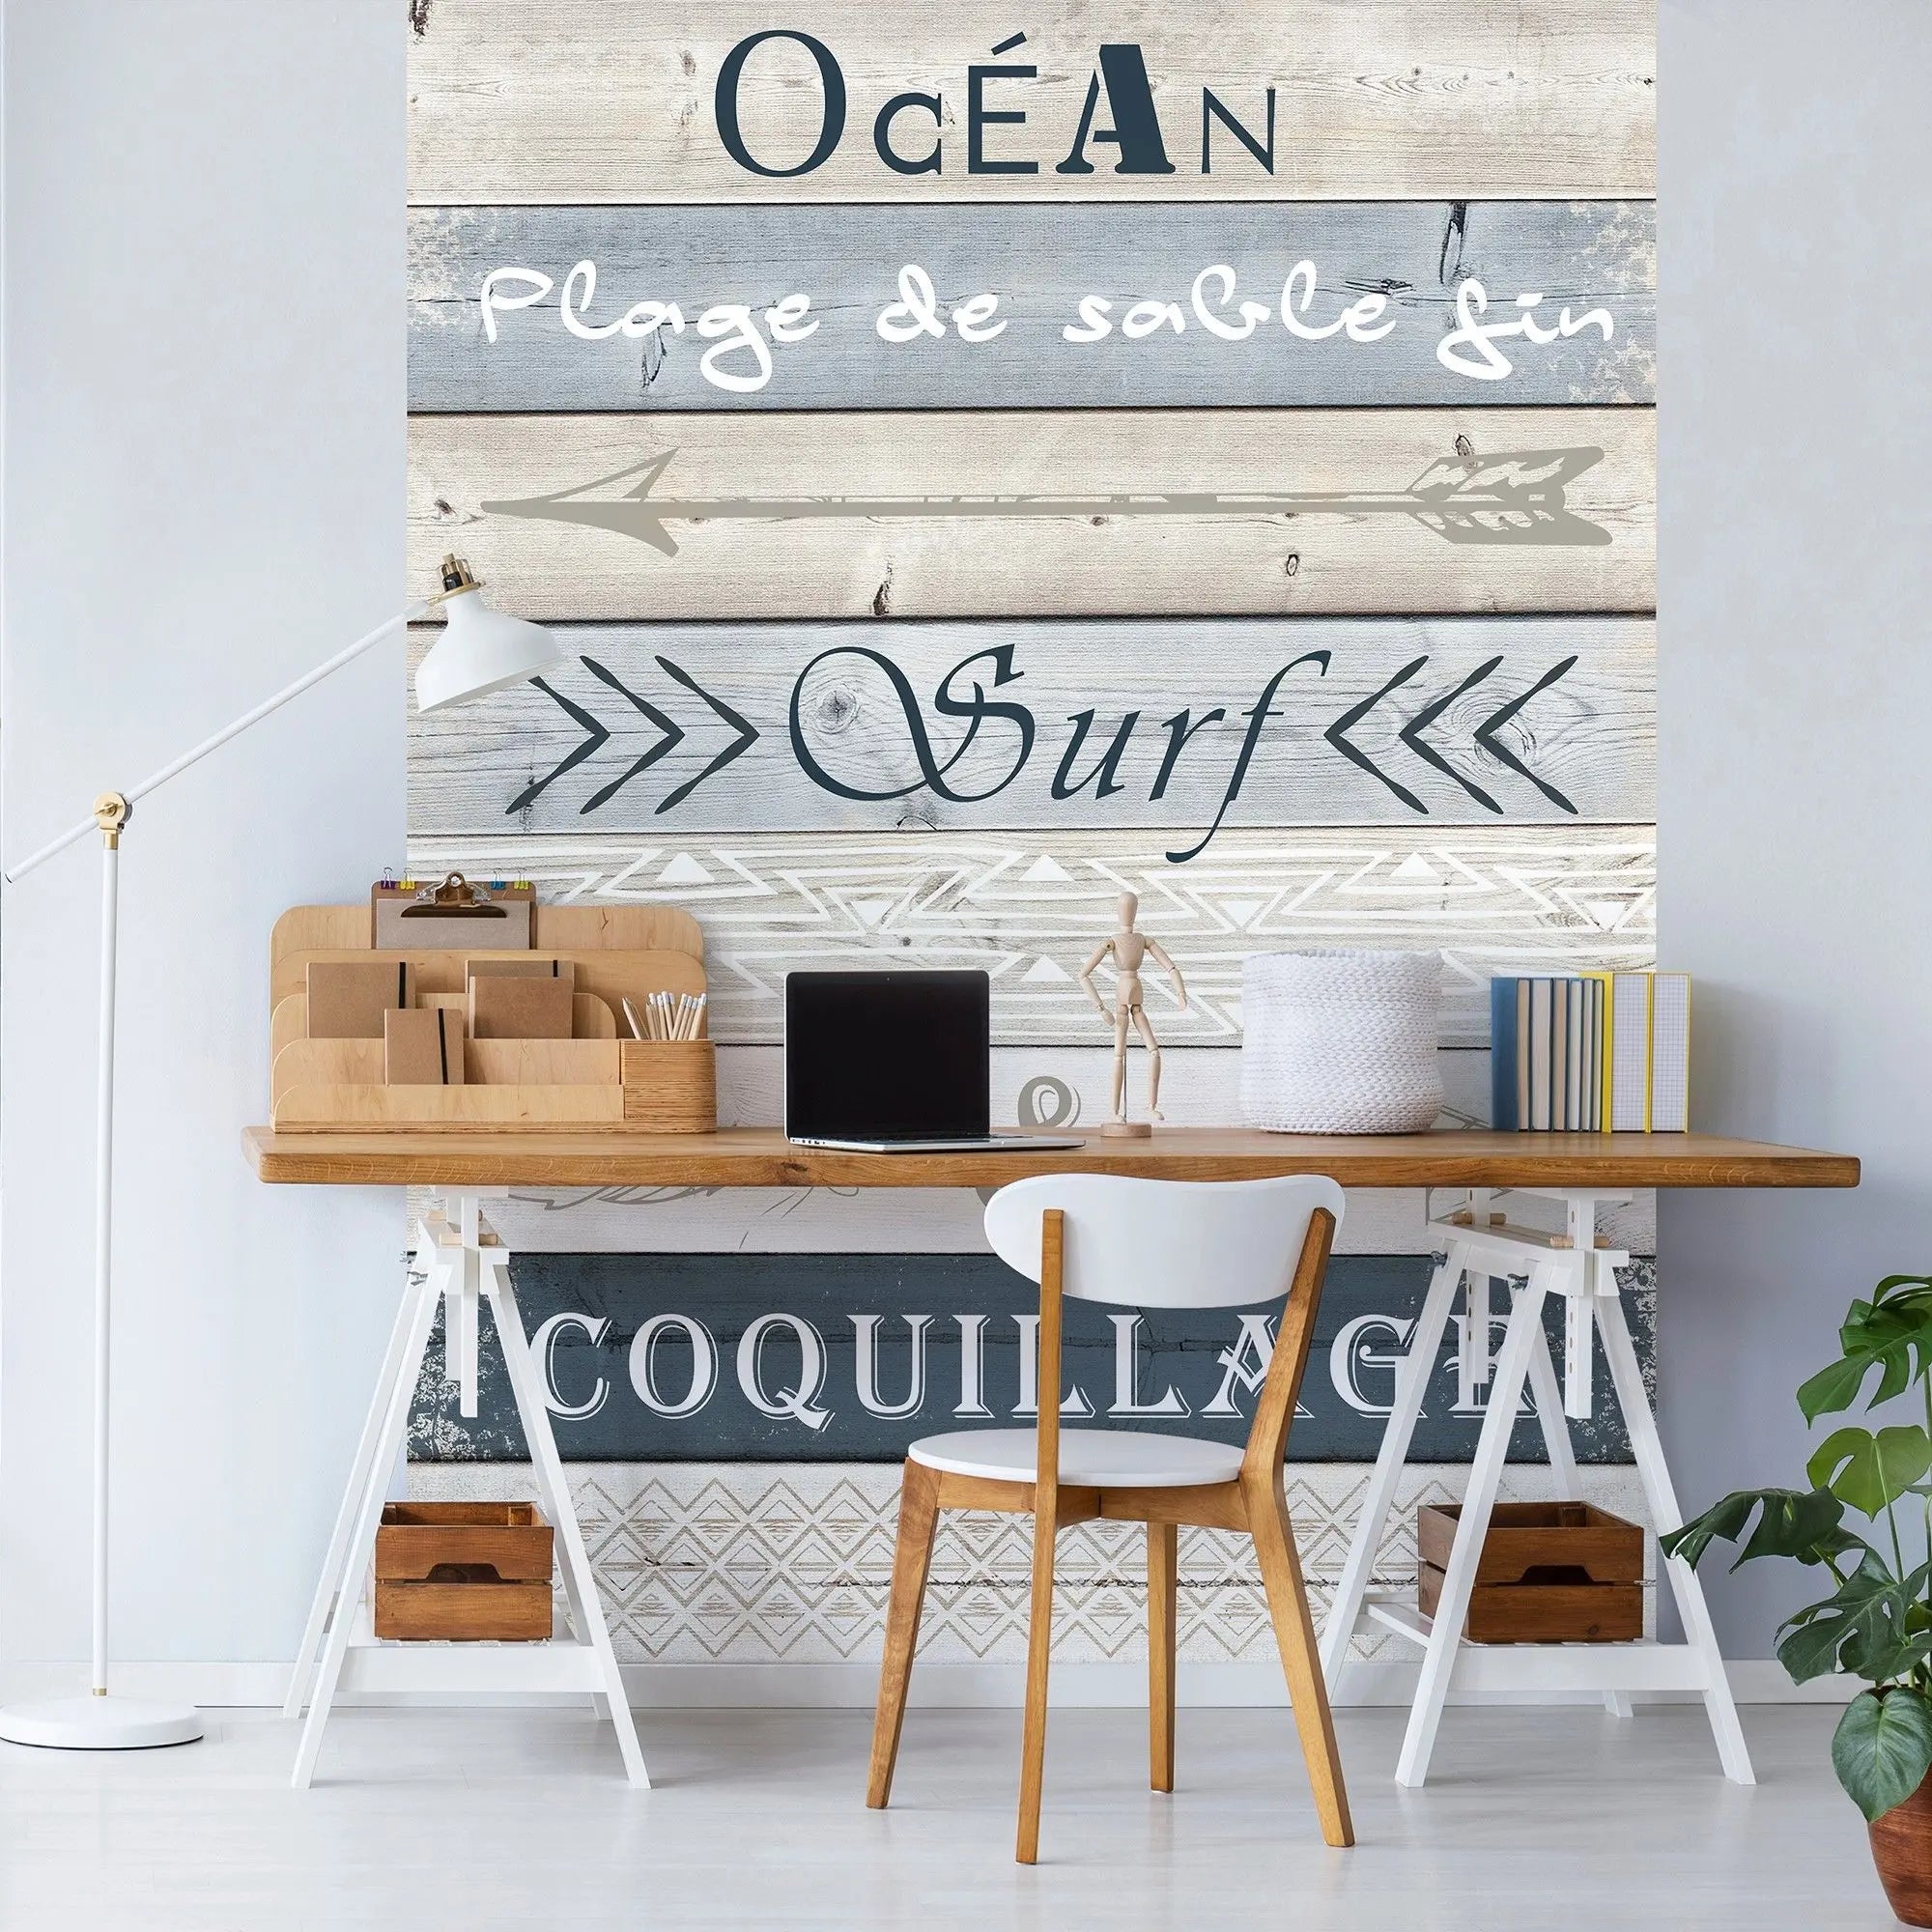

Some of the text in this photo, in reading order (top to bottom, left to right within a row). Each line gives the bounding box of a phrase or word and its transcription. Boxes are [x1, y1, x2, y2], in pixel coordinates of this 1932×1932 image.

[479, 259, 1614, 393] Plage de sable fin
[788, 643, 1332, 864] Surf
